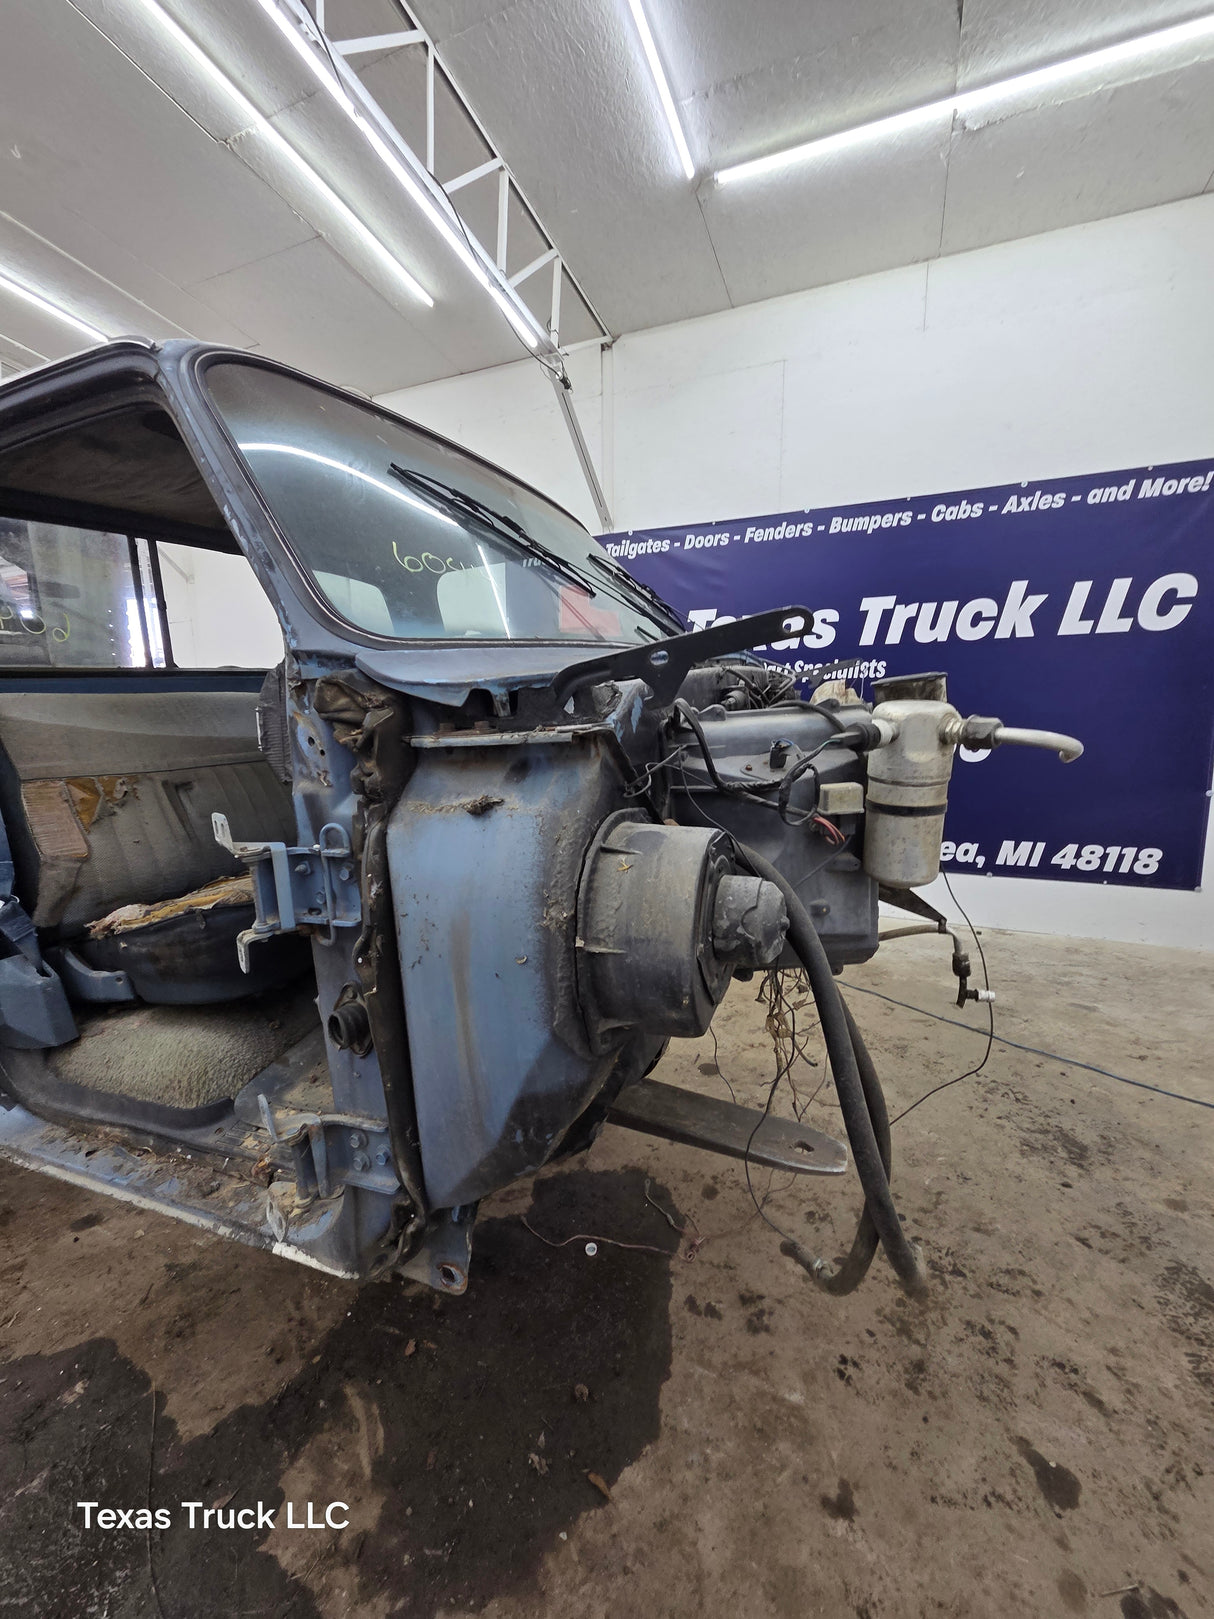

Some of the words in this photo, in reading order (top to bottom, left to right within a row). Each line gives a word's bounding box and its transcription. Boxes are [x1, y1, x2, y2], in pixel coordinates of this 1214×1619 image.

[605, 538, 670, 560] Tailgates
[683, 531, 730, 550] Doors
[744, 522, 814, 544] Fenders
[828, 509, 913, 534] Bumpers
[931, 500, 984, 523] Cabs
[1001, 490, 1066, 515] Axles
[1086, 479, 1137, 505] and
[1138, 471, 1213, 499] More!
[858, 579, 1049, 647] Truck
[1056, 572, 1199, 637] LLC
[994, 839, 1047, 868] MI
[1050, 843, 1164, 875] 48118
